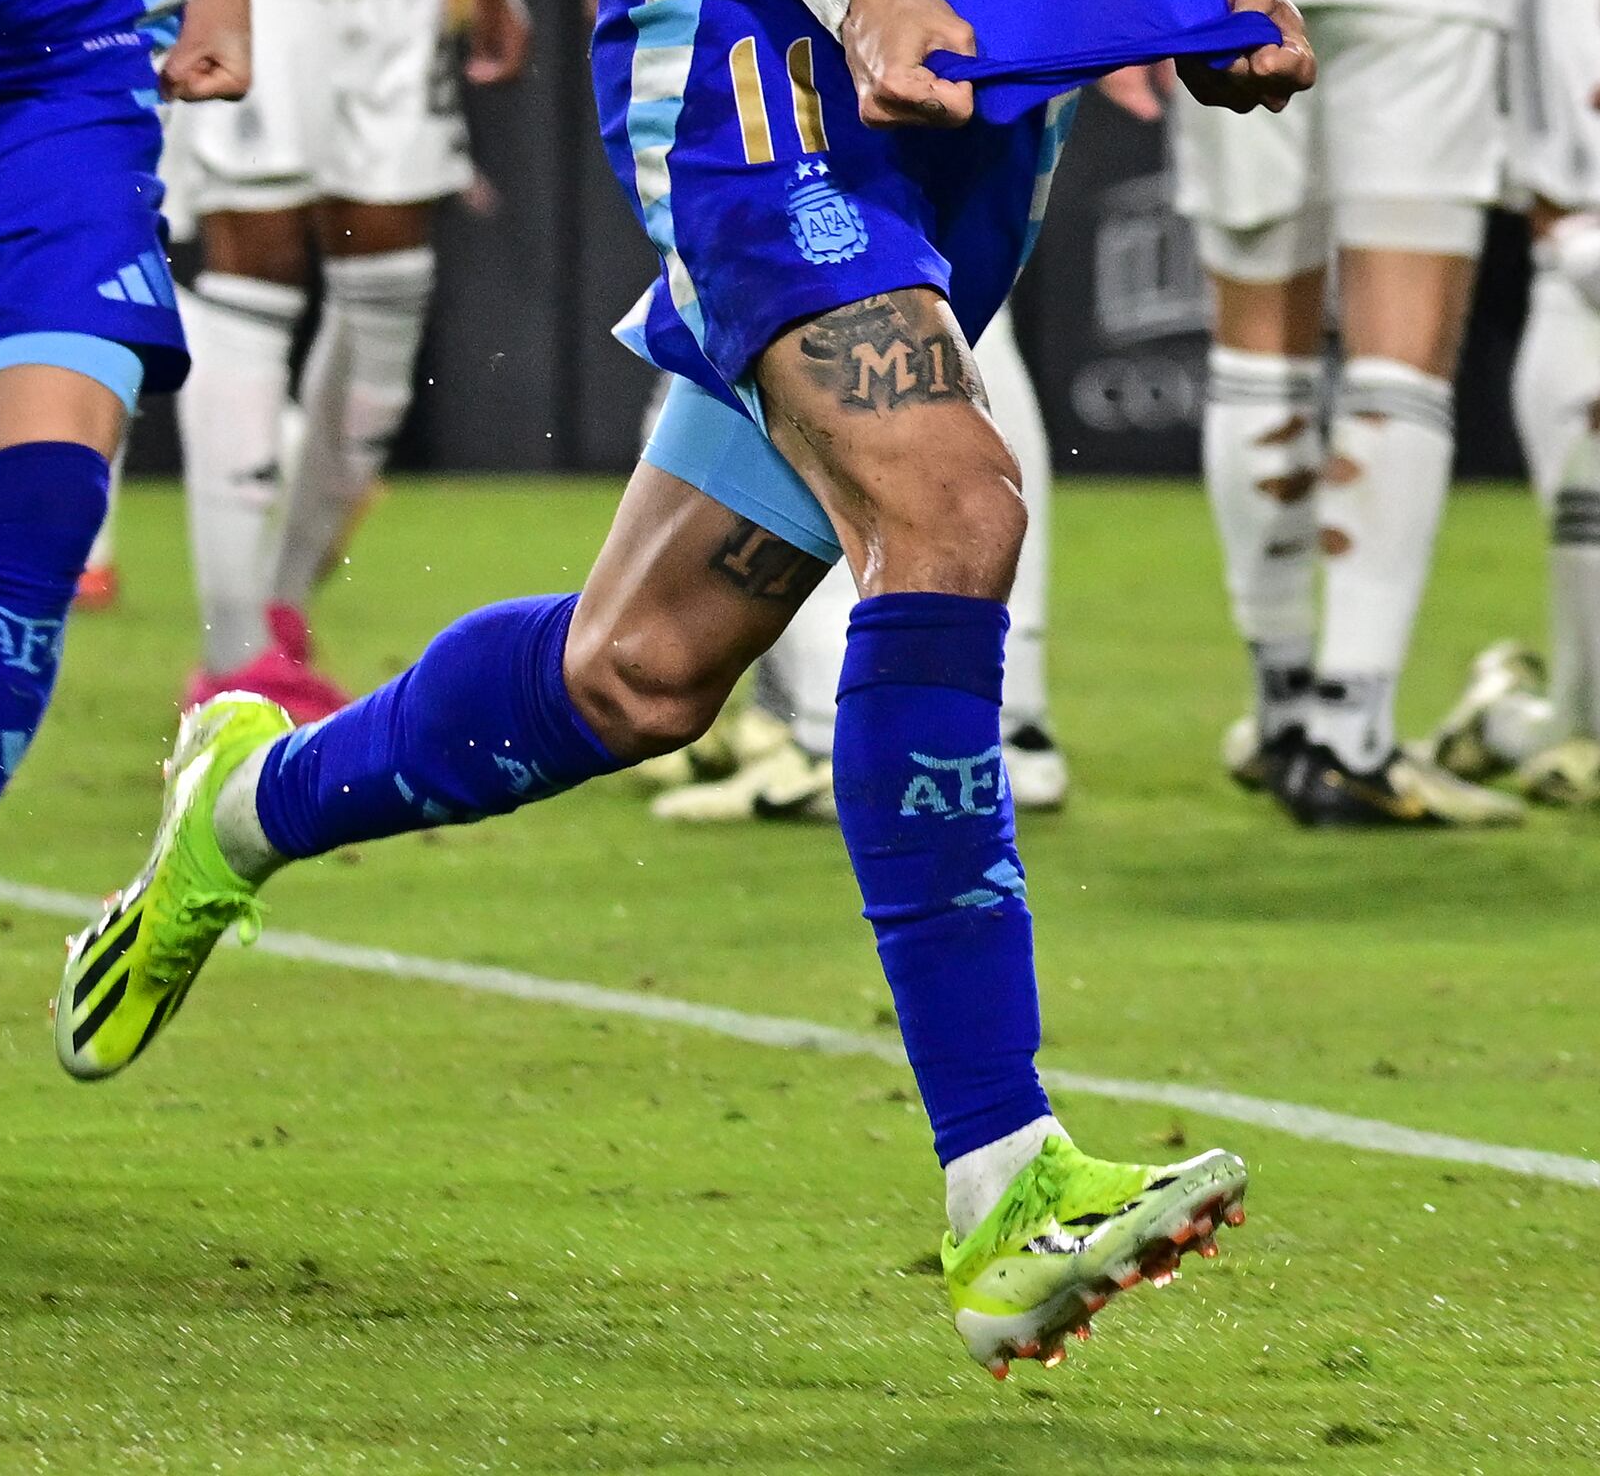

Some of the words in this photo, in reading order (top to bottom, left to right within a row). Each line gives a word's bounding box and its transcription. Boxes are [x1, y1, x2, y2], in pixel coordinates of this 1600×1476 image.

[728, 35, 830, 165] 11
[806, 201, 851, 239] AFA
[899, 743, 1007, 821] AF
